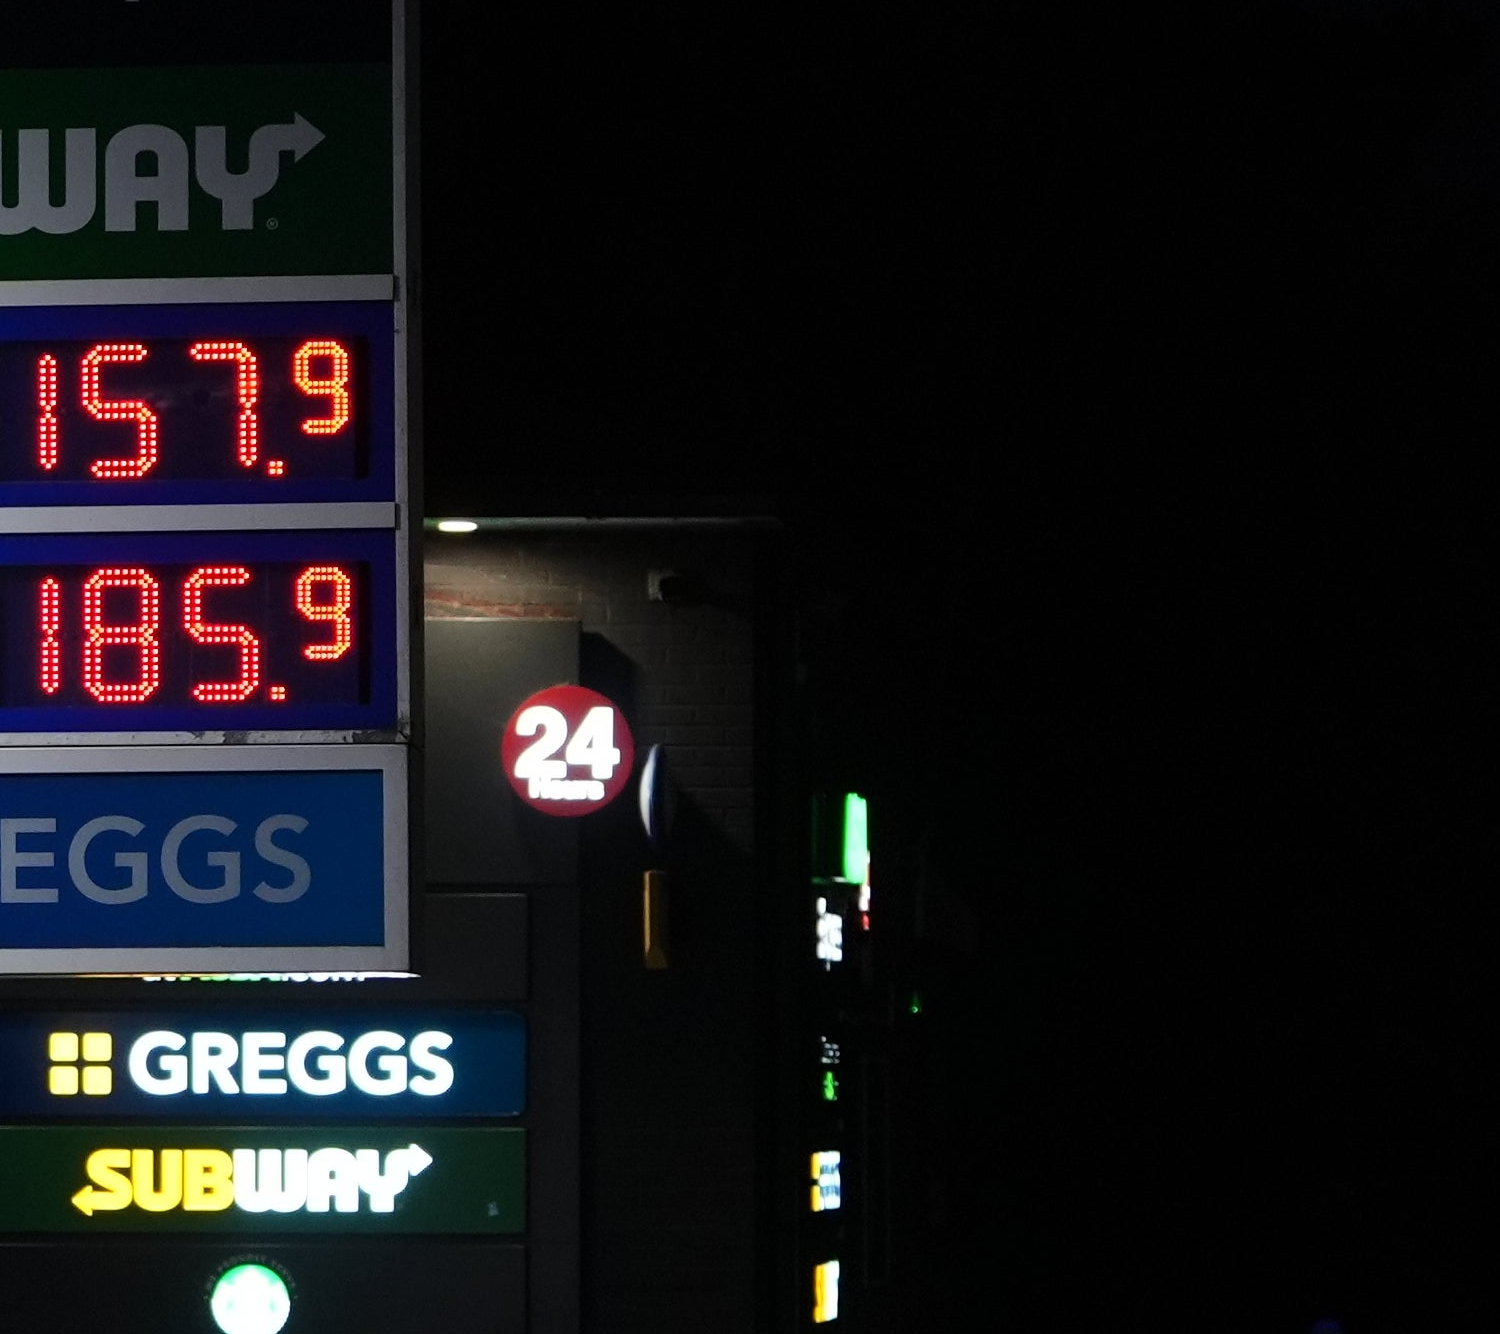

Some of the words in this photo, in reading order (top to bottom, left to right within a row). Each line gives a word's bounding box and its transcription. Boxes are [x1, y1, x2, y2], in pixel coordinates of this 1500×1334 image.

[36, 337, 354, 480] 157.9
[36, 564, 355, 705] 185.9
[514, 705, 621, 779] 24
[127, 1028, 456, 1097] GREGGS
[71, 1142, 434, 1217] SUBWAY
